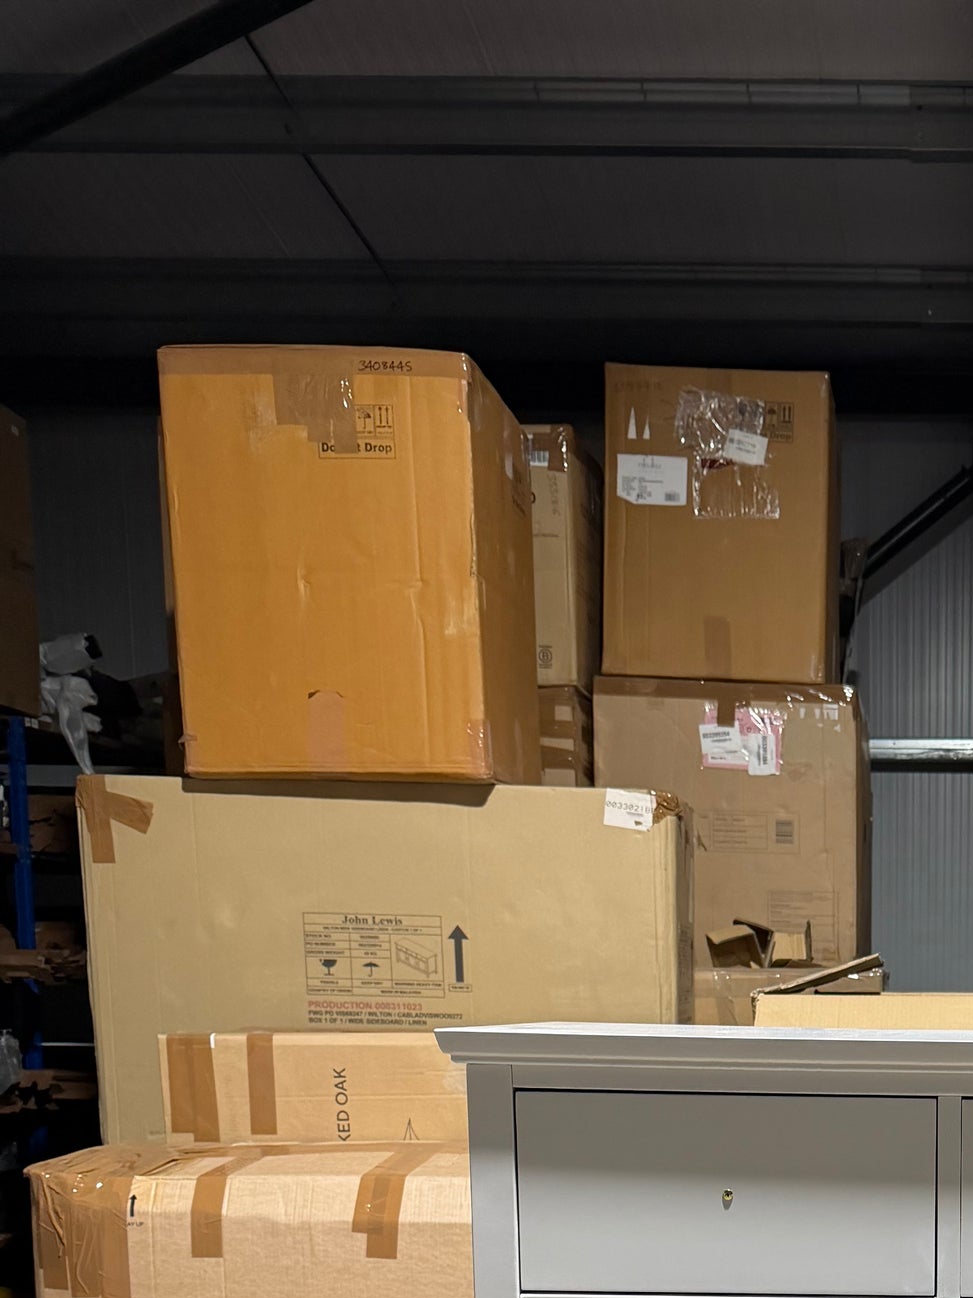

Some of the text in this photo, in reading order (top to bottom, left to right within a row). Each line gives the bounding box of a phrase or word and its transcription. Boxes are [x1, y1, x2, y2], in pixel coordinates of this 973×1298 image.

[364, 442, 392, 454] Drop
[342, 915, 402, 926] John Lewis
[308, 1000, 372, 1010] PRODUCTION
[333, 1068, 348, 1106] OAK
